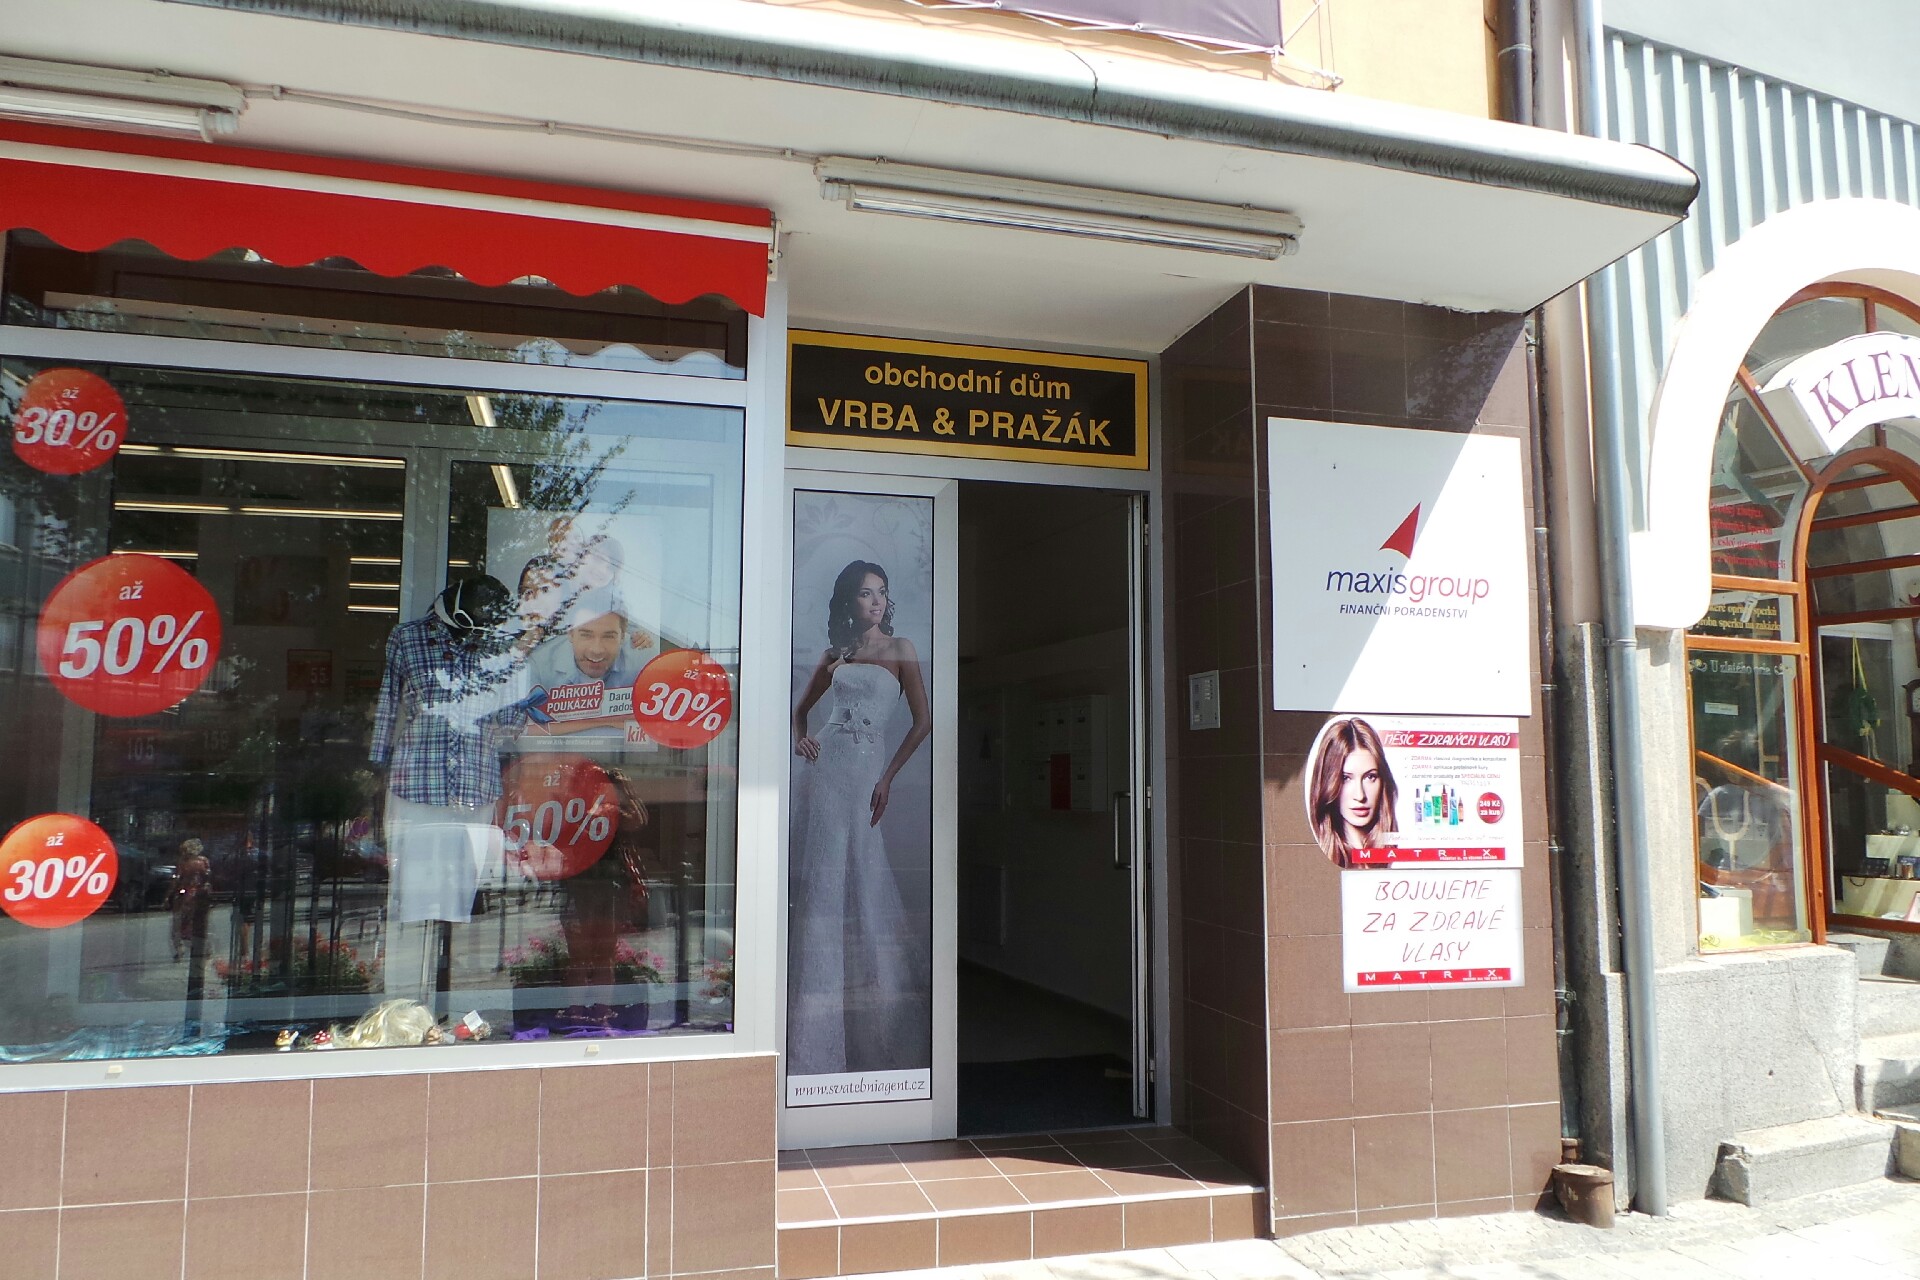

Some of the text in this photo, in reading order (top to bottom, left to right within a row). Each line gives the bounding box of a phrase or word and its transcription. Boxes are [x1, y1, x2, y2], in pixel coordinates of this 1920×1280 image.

[864, 362, 1071, 400] obchodní dům
[61, 387, 79, 399] až
[15, 407, 117, 450] 30%
[817, 398, 1111, 447] VRBA & PRAŽÁK
[118, 580, 143, 600] až
[1326, 567, 1490, 605] maxisgroup
[59, 610, 209, 679] 50%
[683, 668, 699, 680] až
[551, 681, 602, 700] DÁRKOVÉ
[546, 695, 600, 713] POUKÁZKY
[639, 682, 726, 731] 30%
[543, 769, 560, 787] až
[502, 795, 609, 850] 50%
[46, 832, 64, 847] až
[4, 852, 109, 901] 30%
[1375, 879, 1493, 901] BOJUJEME
[1362, 905, 1505, 932] ZA ZDRAVÉ
[1402, 941, 1471, 962] VLASY
[794, 1077, 925, 1096] www.svatebniagent.cz
